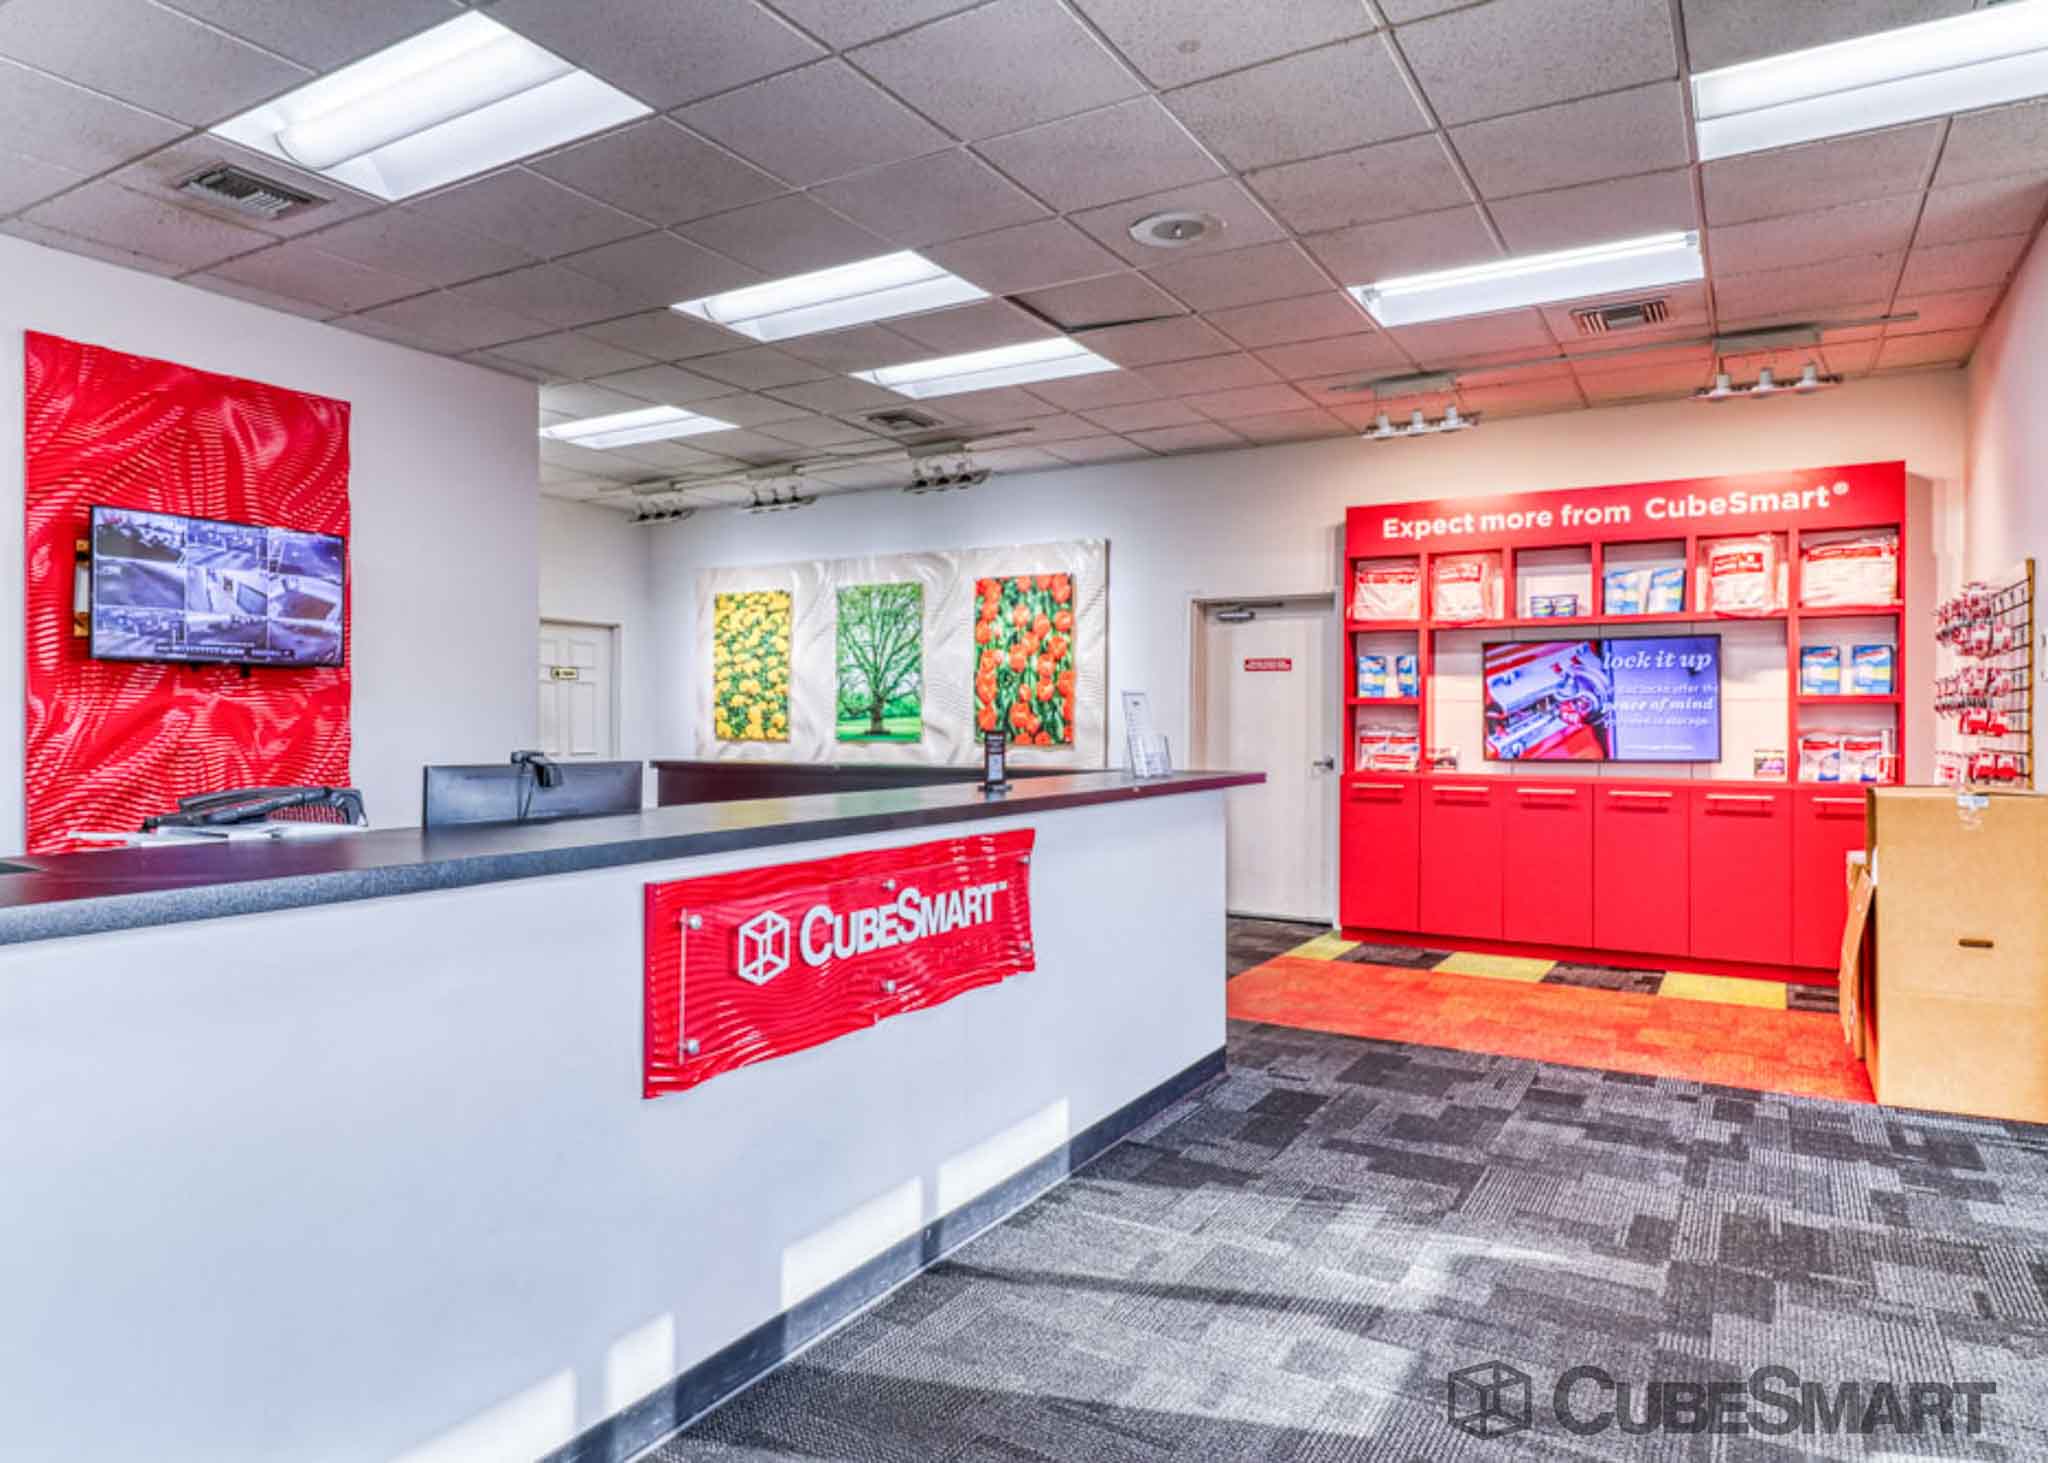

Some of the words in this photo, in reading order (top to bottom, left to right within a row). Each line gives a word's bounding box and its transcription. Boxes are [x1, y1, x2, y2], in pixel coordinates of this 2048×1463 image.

[1383, 512, 1475, 540] Expect
[1480, 510, 1554, 531] more
[1560, 503, 1632, 526] from
[1603, 650, 1652, 670] lock
[1655, 650, 1677, 668] it
[1680, 653, 1713, 671] up
